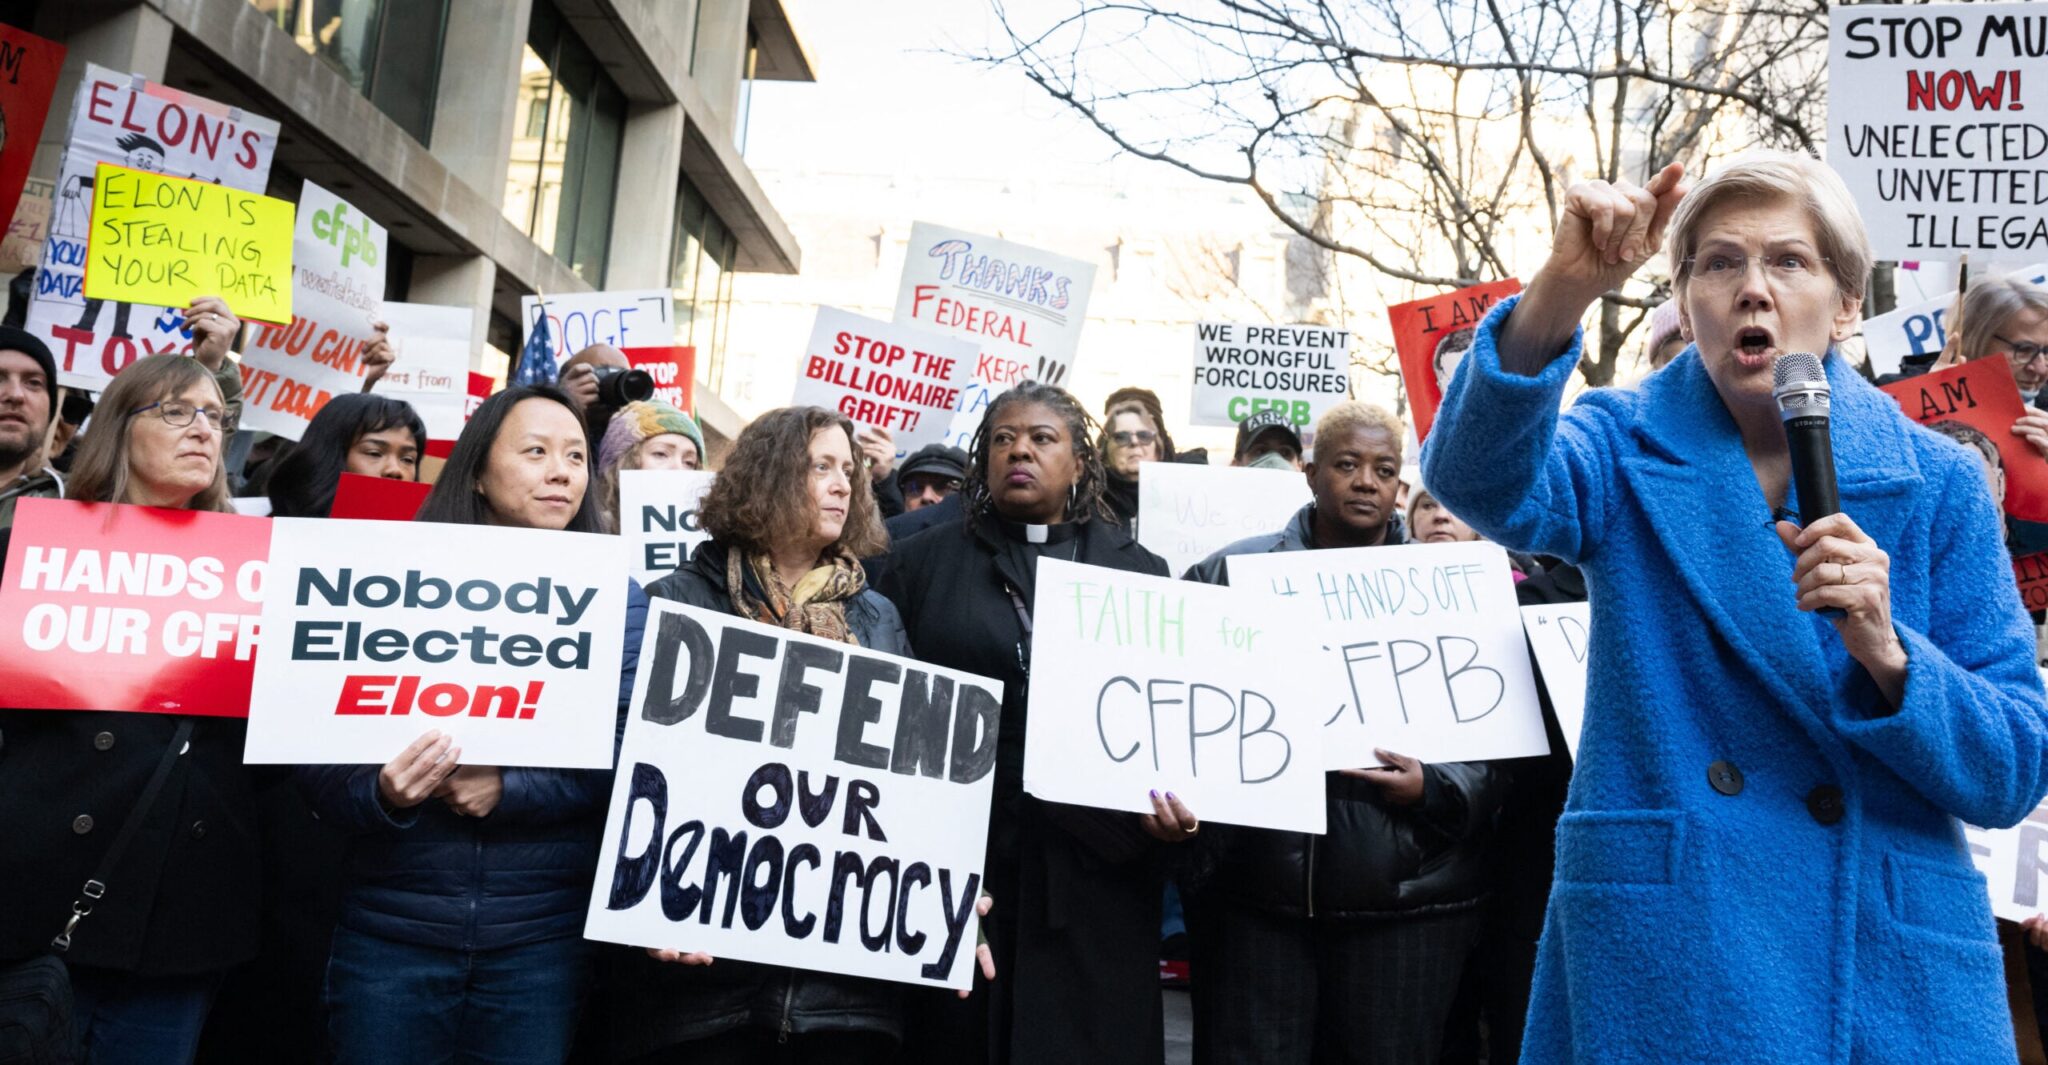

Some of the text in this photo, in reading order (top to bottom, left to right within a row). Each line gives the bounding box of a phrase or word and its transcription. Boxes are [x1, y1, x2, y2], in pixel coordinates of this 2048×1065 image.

[1845, 14, 2048, 60] STOP MU
[1907, 69, 2025, 112] NOW!
[88, 79, 261, 171] ELON'S
[1844, 123, 2048, 162] UNELECTED
[103, 172, 257, 226] ELON IS
[102, 217, 262, 268] STEALING
[311, 202, 378, 267] cfpb
[103, 253, 279, 305] YOUR DATA
[928, 239, 1073, 310] THANKS
[911, 284, 1032, 348] FEDERAL
[1198, 323, 1349, 349] WE PREVENT
[1418, 293, 1491, 333] I AM
[805, 354, 959, 411] BILLIONAIRE
[834, 331, 956, 381] STOP THE
[1193, 366, 1347, 394] FORCLOSURES
[1206, 346, 1336, 370] WRONGFUL
[837, 394, 921, 433] GRIFT!
[1919, 377, 1977, 420] AM
[19, 546, 224, 599] HANDS
[295, 567, 599, 627] Nobody
[22, 603, 151, 656] OUR
[291, 620, 592, 671] Elected
[1067, 581, 1261, 657] FAITH for
[334, 675, 545, 720] Elon!
[641, 610, 1003, 785] DEFEND
[1323, 636, 1505, 727] FPB
[1096, 675, 1292, 784] CFPB
[741, 762, 888, 844] OUR
[605, 762, 981, 982] Democracy
